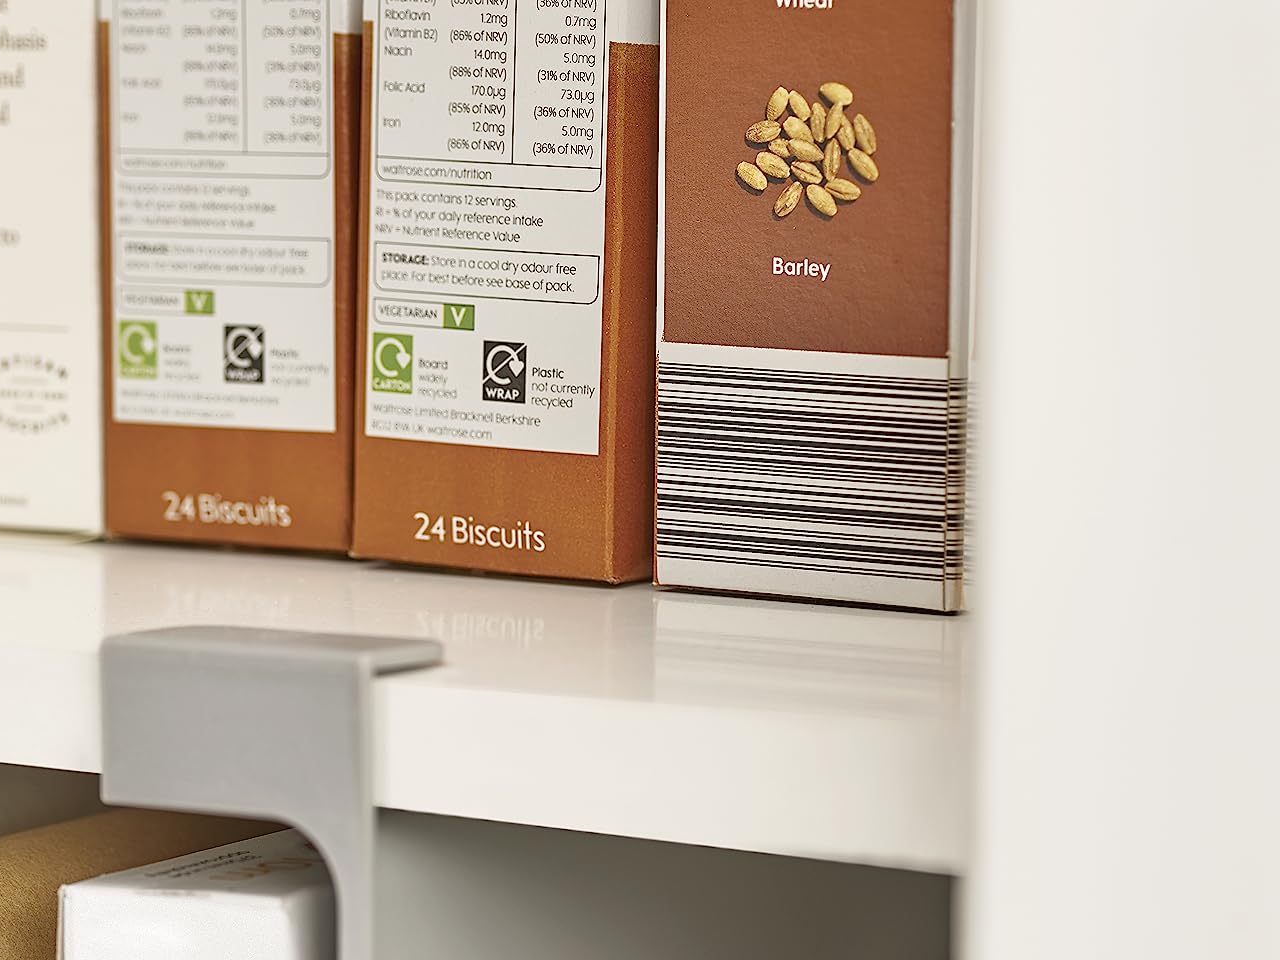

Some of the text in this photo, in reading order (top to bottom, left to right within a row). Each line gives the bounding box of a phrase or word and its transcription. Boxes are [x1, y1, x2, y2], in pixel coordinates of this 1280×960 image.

[480, 12, 508, 28] 1.2mg
[565, 16, 596, 30] 0.7mg
[473, 30, 485, 41] of
[485, 31, 508, 46] NRV)
[536, 33, 596, 49] (50% of NRV)
[474, 49, 507, 64] 14.0mg
[564, 53, 595, 67] 5.0mg
[473, 66, 484, 77] of
[485, 67, 507, 82] NRV)
[538, 69, 595, 86] (31% of NRV)
[448, 102, 506, 118] (85% of NRV)
[534, 106, 594, 122] (36% of NRV)
[472, 121, 505, 136] 12.0mg
[562, 126, 593, 140] 5.0mg
[471, 139, 482, 150] of
[483, 140, 505, 154] NRV)
[533, 142, 593, 159] (36% of NRV)
[383, 165, 492, 180] waitrose.com/nutrition
[421, 193, 462, 205] contains
[465, 195, 473, 205] 12
[402, 208, 412, 218] of
[415, 211, 436, 222] your
[438, 211, 461, 225] daily
[463, 213, 510, 225] reference
[513, 215, 543, 227] intake
[442, 228, 490, 241] Reference
[492, 231, 520, 243] Value
[469, 260, 475, 269] a
[477, 259, 499, 271] cool
[501, 260, 519, 275] dry
[521, 262, 554, 274] odour
[556, 263, 576, 275] free
[772, 257, 831, 281] Barley
[429, 272, 449, 284] best
[451, 274, 484, 287] before
[486, 278, 503, 288] see
[506, 277, 530, 289] base
[532, 278, 544, 291] of
[546, 280, 575, 293] pack.
[379, 304, 437, 319] VEGETARIAN
[451, 306, 466, 327] V
[419, 358, 448, 370] Board
[532, 367, 564, 379] Plastic
[485, 387, 520, 401] WRAP
[531, 382, 595, 399] not currently
[531, 396, 573, 410] recycled
[496, 413, 541, 427] Berkshire
[162, 491, 292, 527] 24 Biscuits
[414, 513, 545, 552] 24 Biscuits
